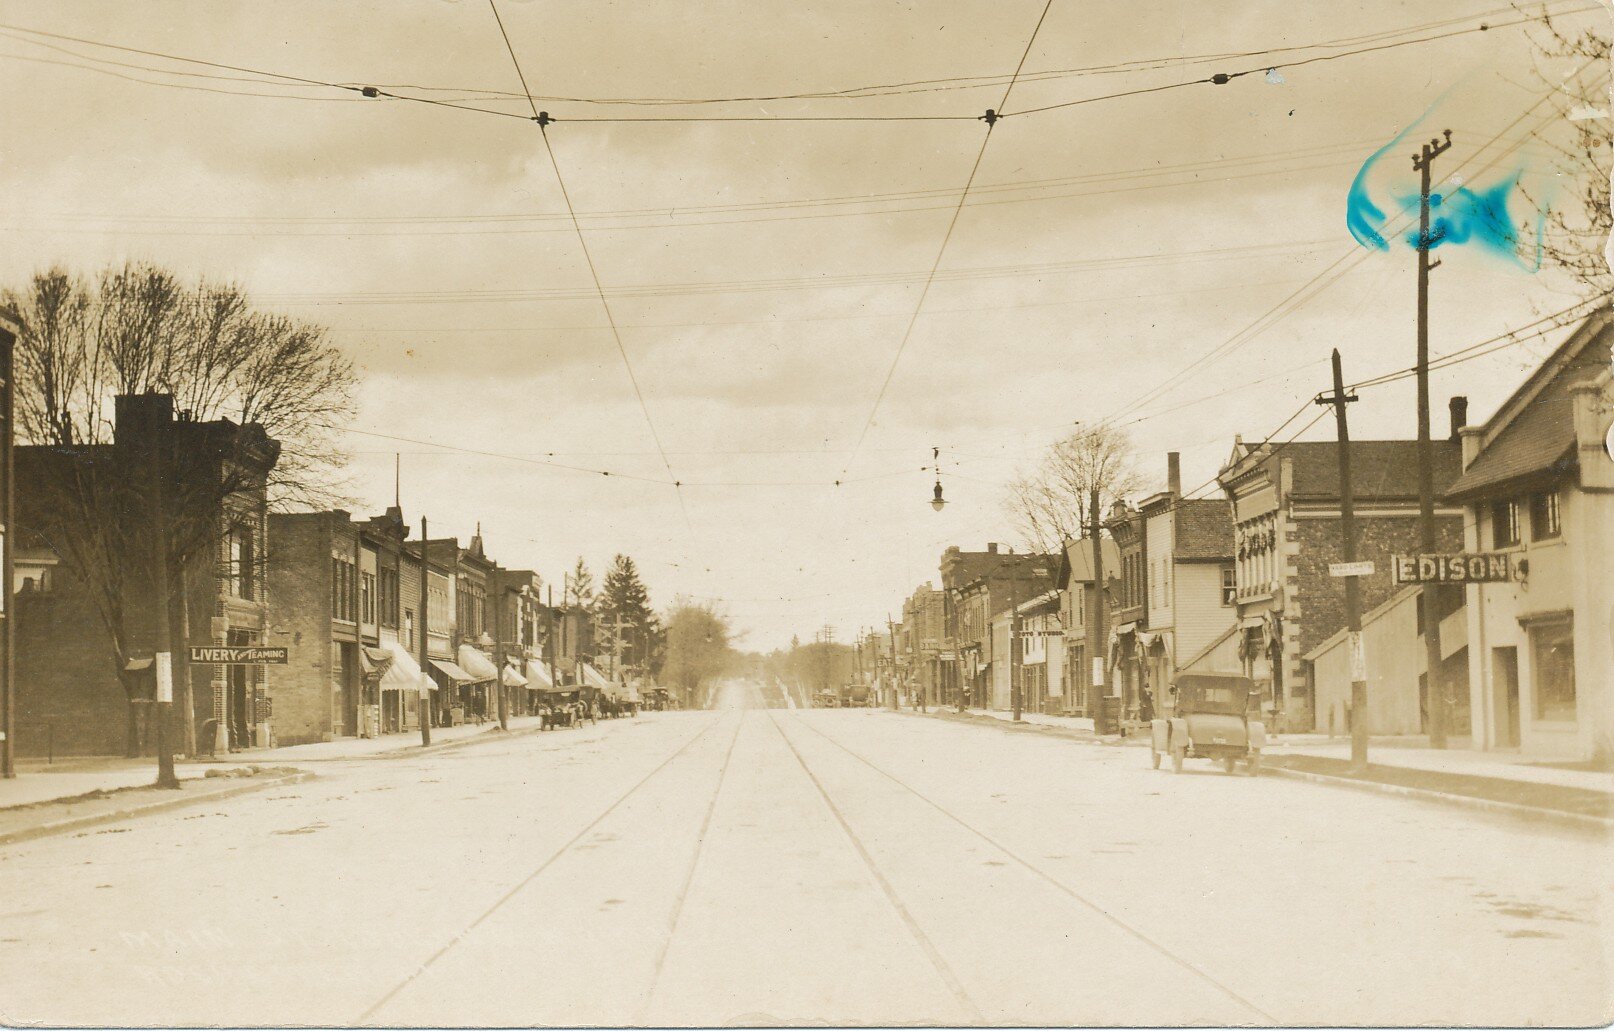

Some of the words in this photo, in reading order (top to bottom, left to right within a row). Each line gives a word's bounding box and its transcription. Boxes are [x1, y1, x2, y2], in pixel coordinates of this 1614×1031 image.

[1399, 556, 1507, 581] EDISON
[192, 648, 239, 661] LIVERY
[247, 649, 285, 659] TEAMING
